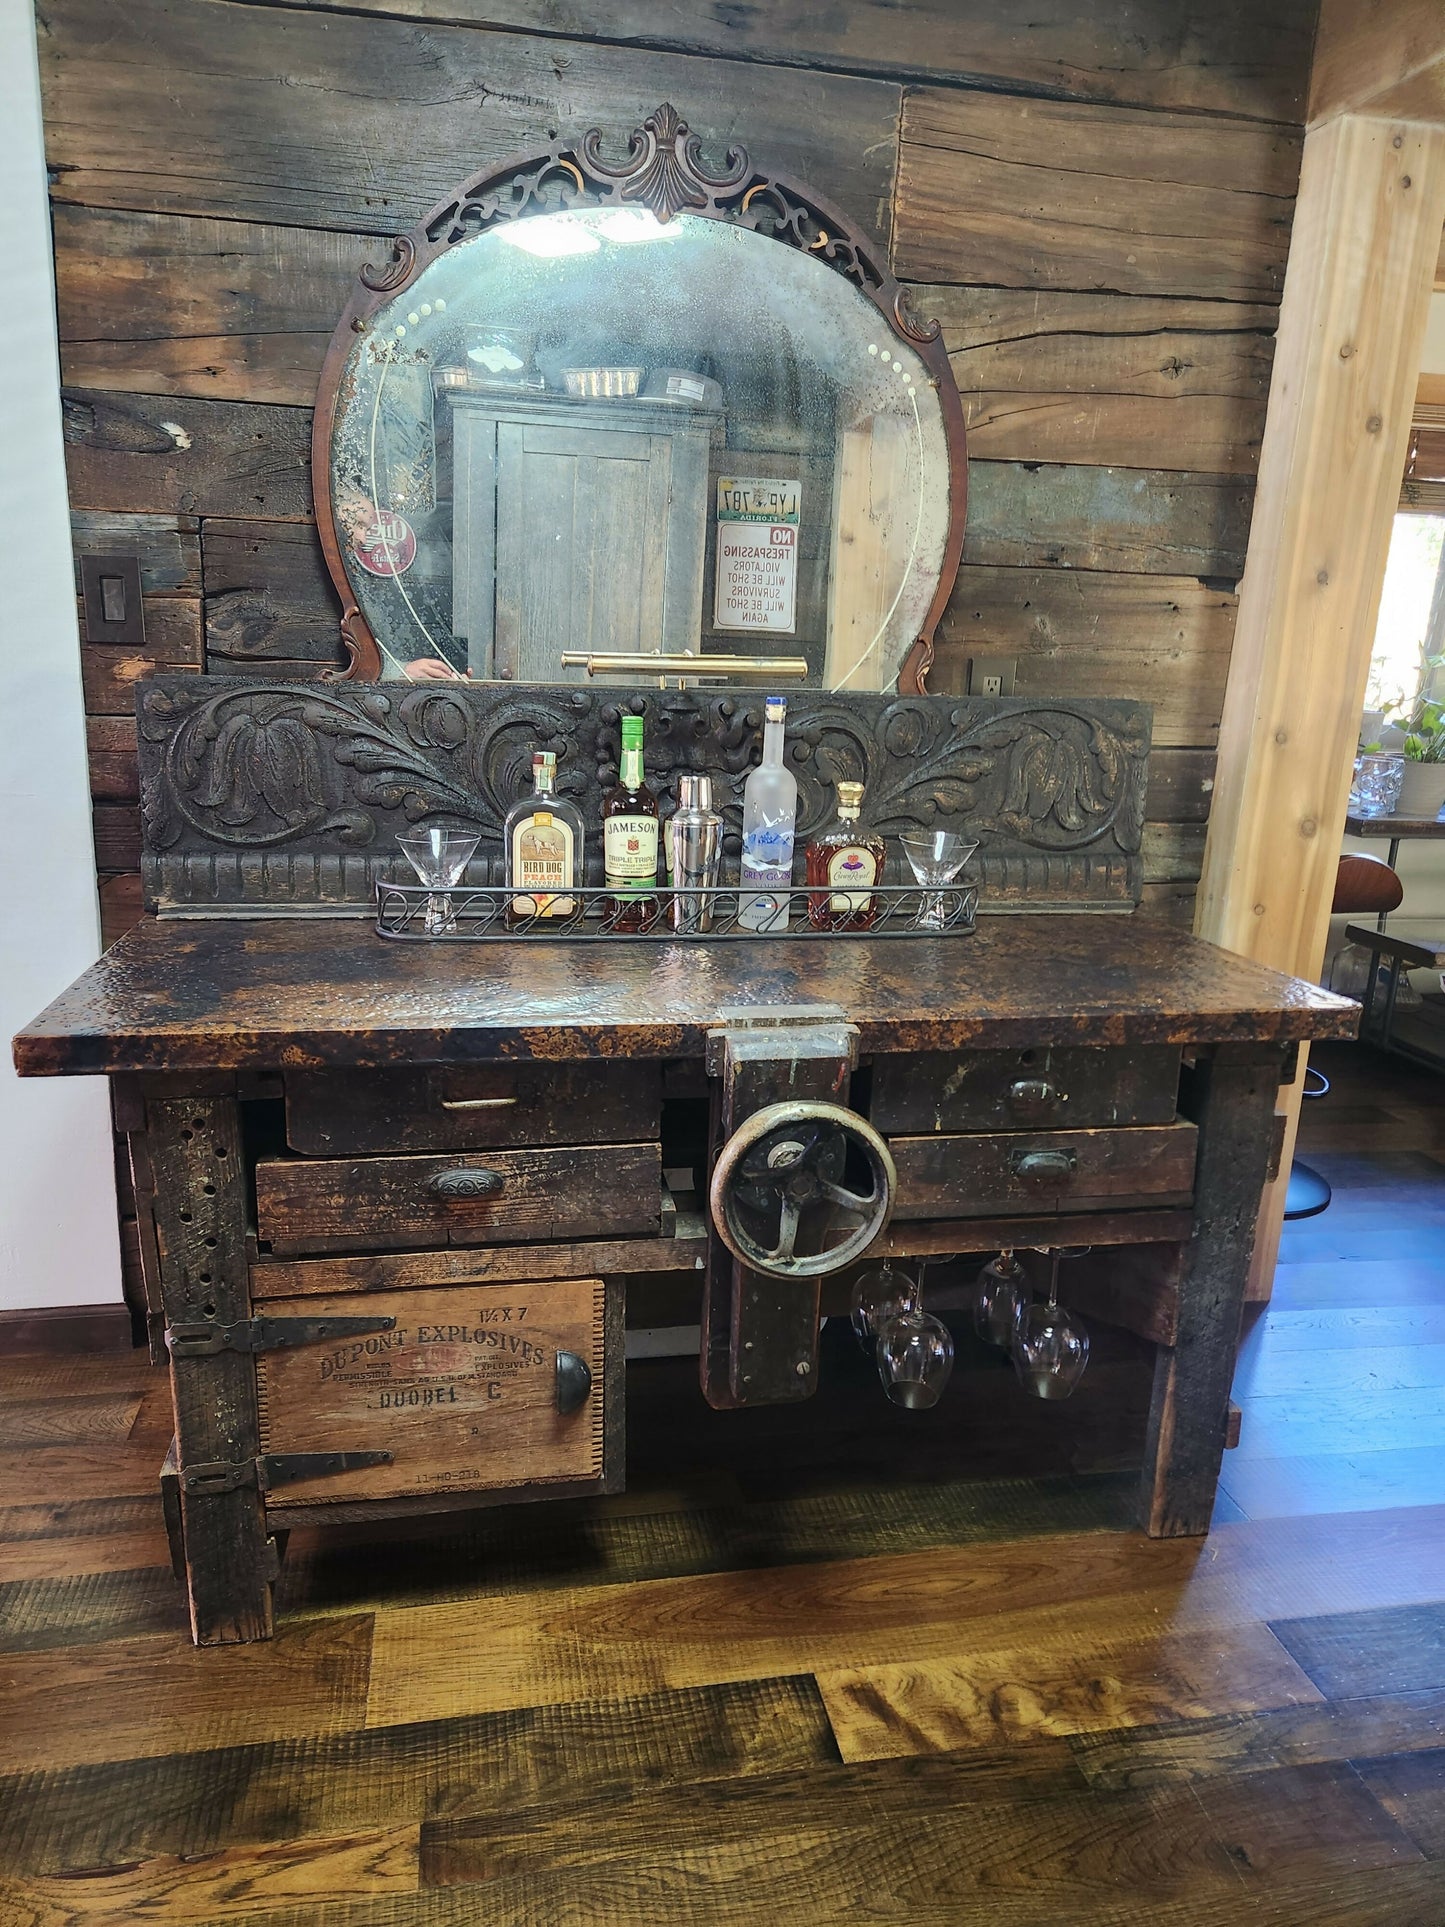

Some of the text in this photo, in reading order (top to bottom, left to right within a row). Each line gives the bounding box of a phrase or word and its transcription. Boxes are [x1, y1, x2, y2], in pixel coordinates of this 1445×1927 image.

[608, 822, 656, 835] JAMESON
[608, 854, 633, 863] TRIPLE
[523, 861, 562, 873] BIRD DOG
[743, 870, 764, 880] GREY
[518, 1307, 528, 1320] 7
[417, 1325, 545, 1366] EXPLOSIVES
[474, 1360, 530, 1372] EXPLOSIVES
[332, 1370, 393, 1382] PERMISSIBLE
[487, 1381, 502, 1400] C
